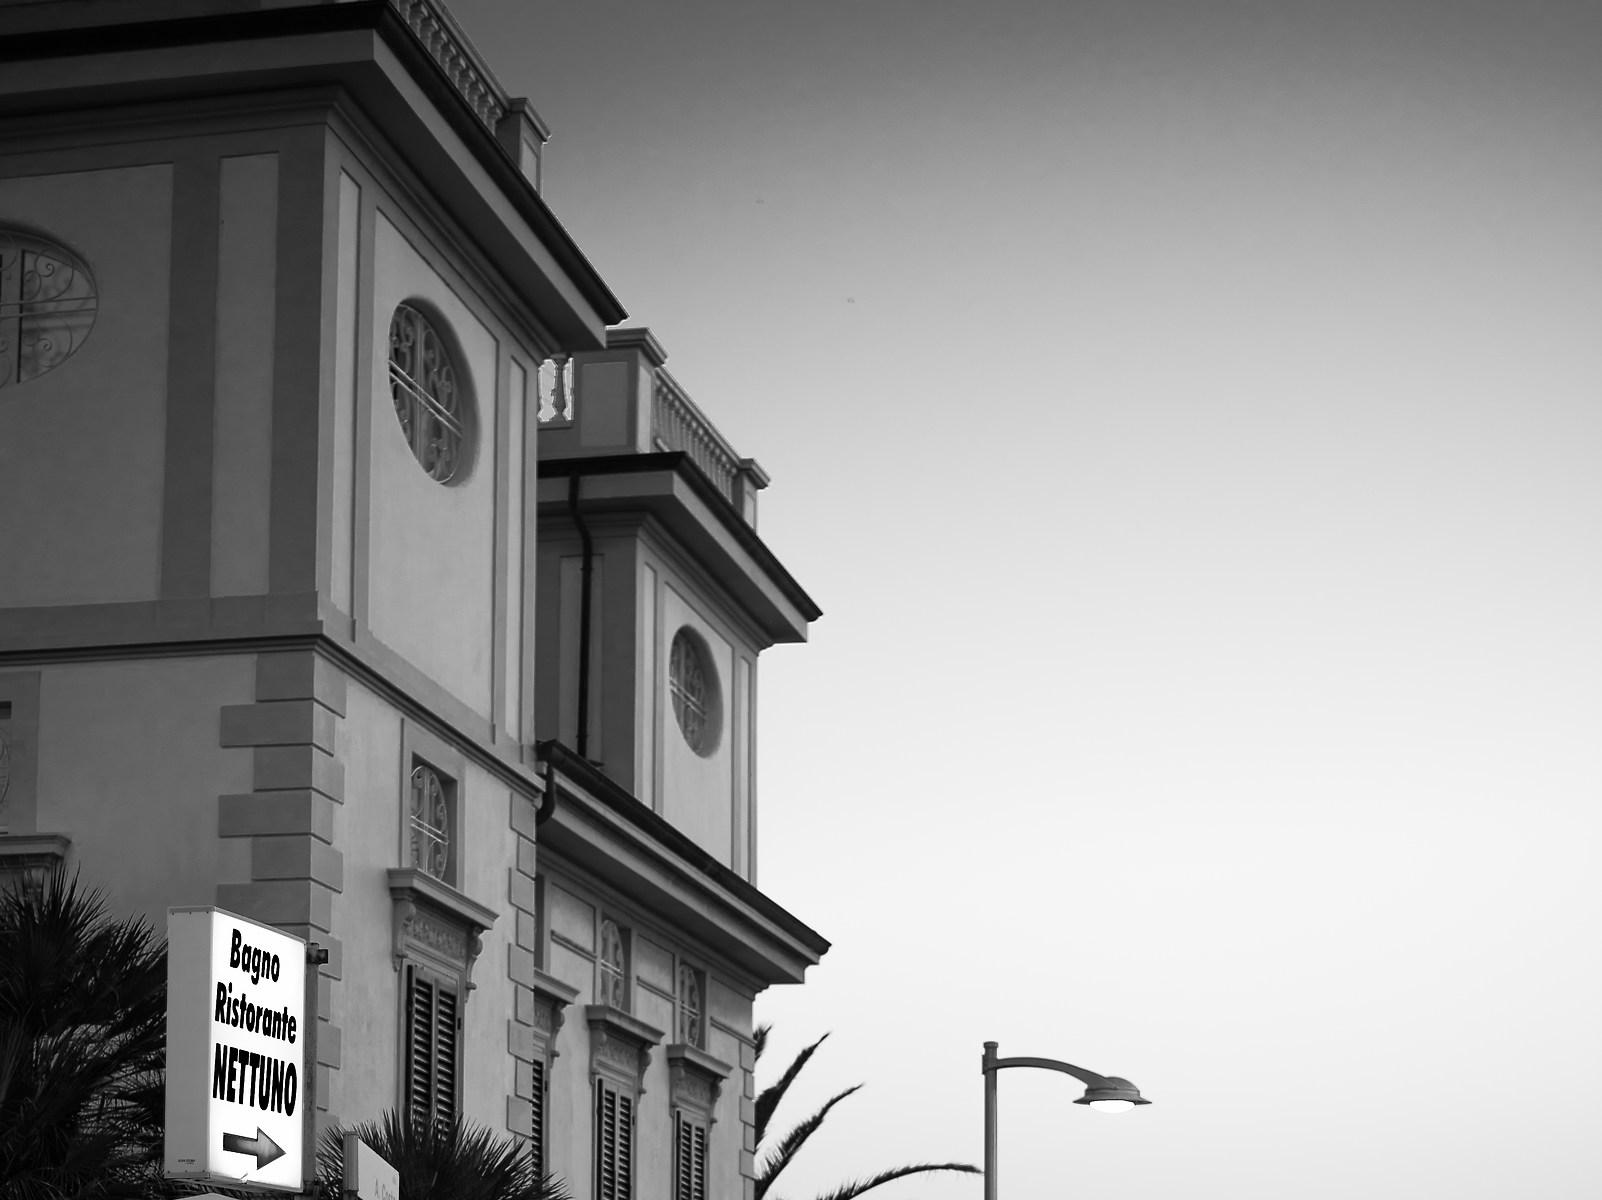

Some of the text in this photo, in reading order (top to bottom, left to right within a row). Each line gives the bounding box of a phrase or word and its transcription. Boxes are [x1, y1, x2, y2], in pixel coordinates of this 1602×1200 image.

[230, 928, 280, 985] Bagno
[214, 982, 297, 1044] Ristorante
[212, 1042, 297, 1117] NETTUNO
